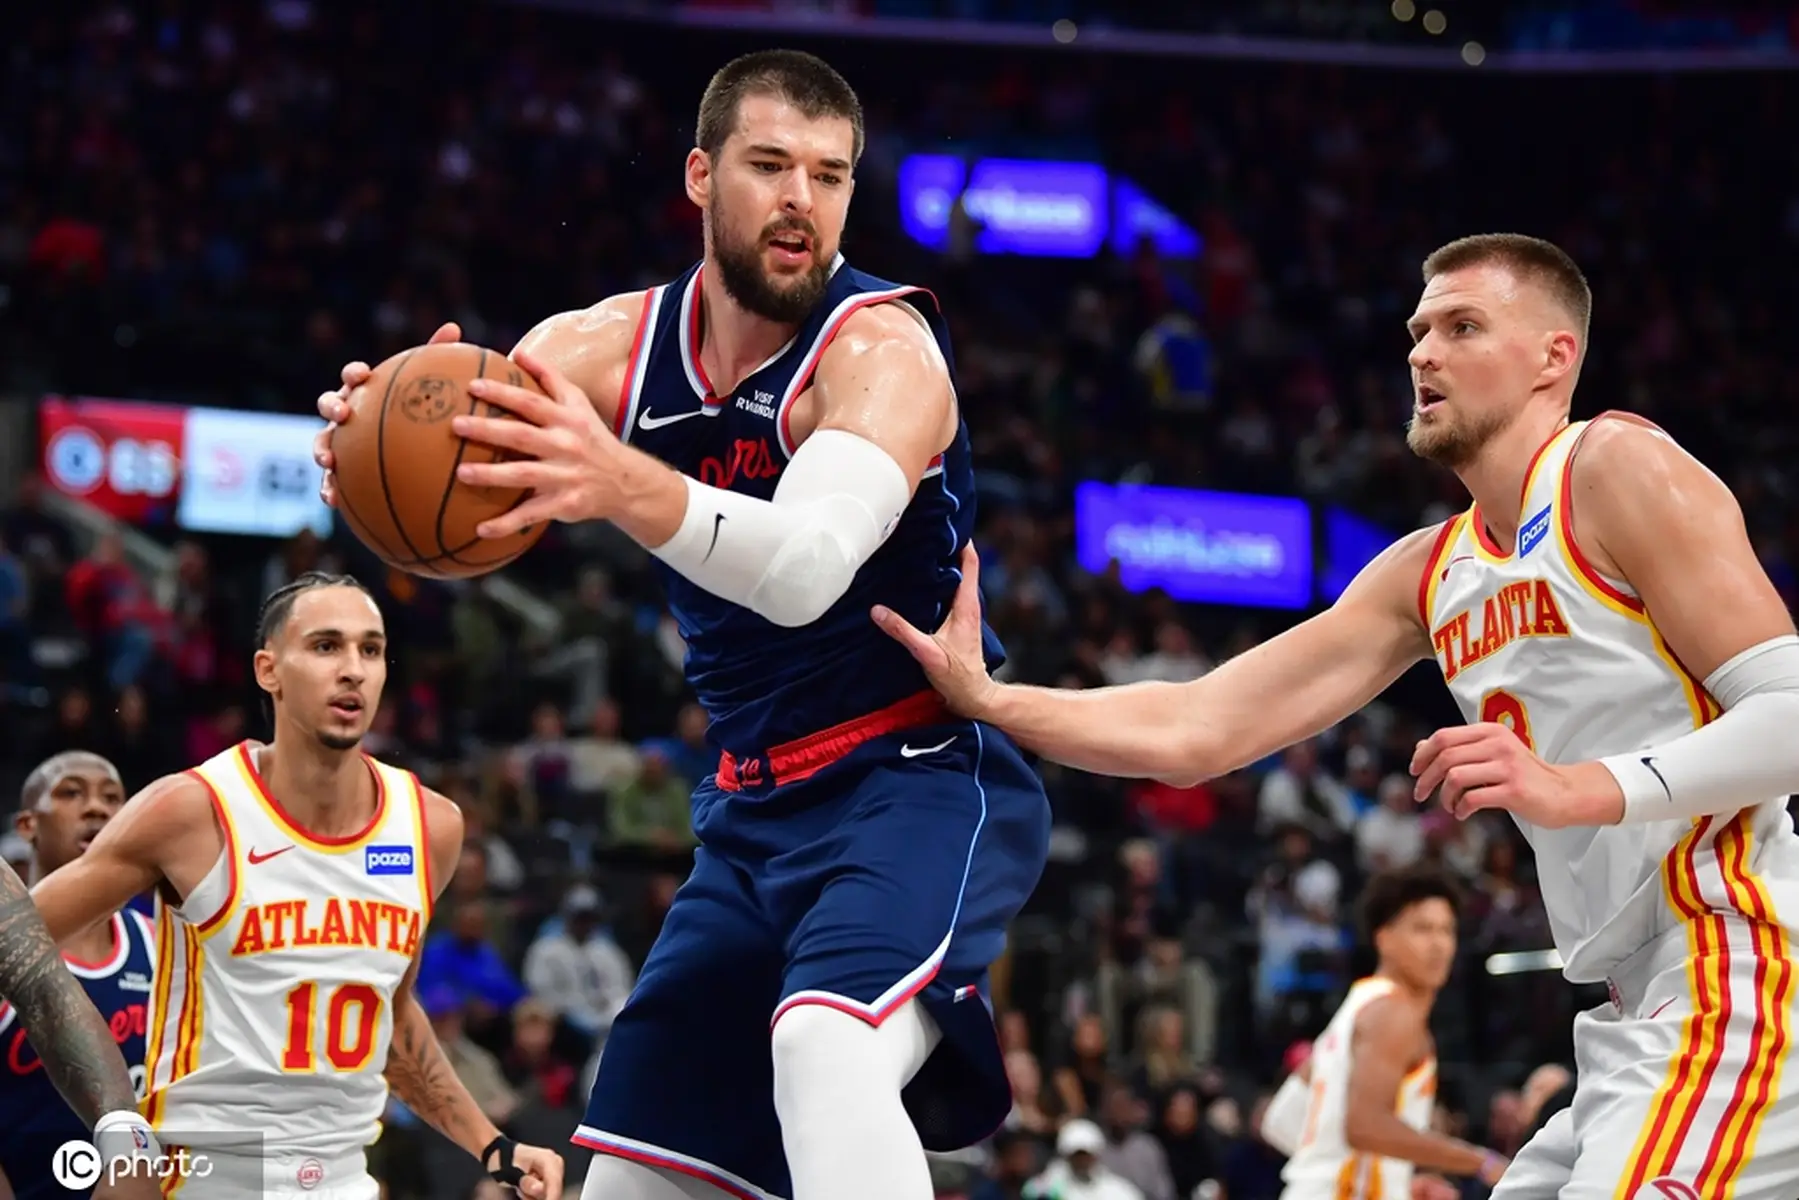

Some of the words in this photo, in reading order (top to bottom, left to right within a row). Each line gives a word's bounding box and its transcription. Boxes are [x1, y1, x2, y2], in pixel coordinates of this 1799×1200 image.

[1434, 579, 1571, 684] TLANTA
[367, 851, 412, 869] paze
[230, 898, 422, 958] ATLANTA
[282, 981, 384, 1072] 10
